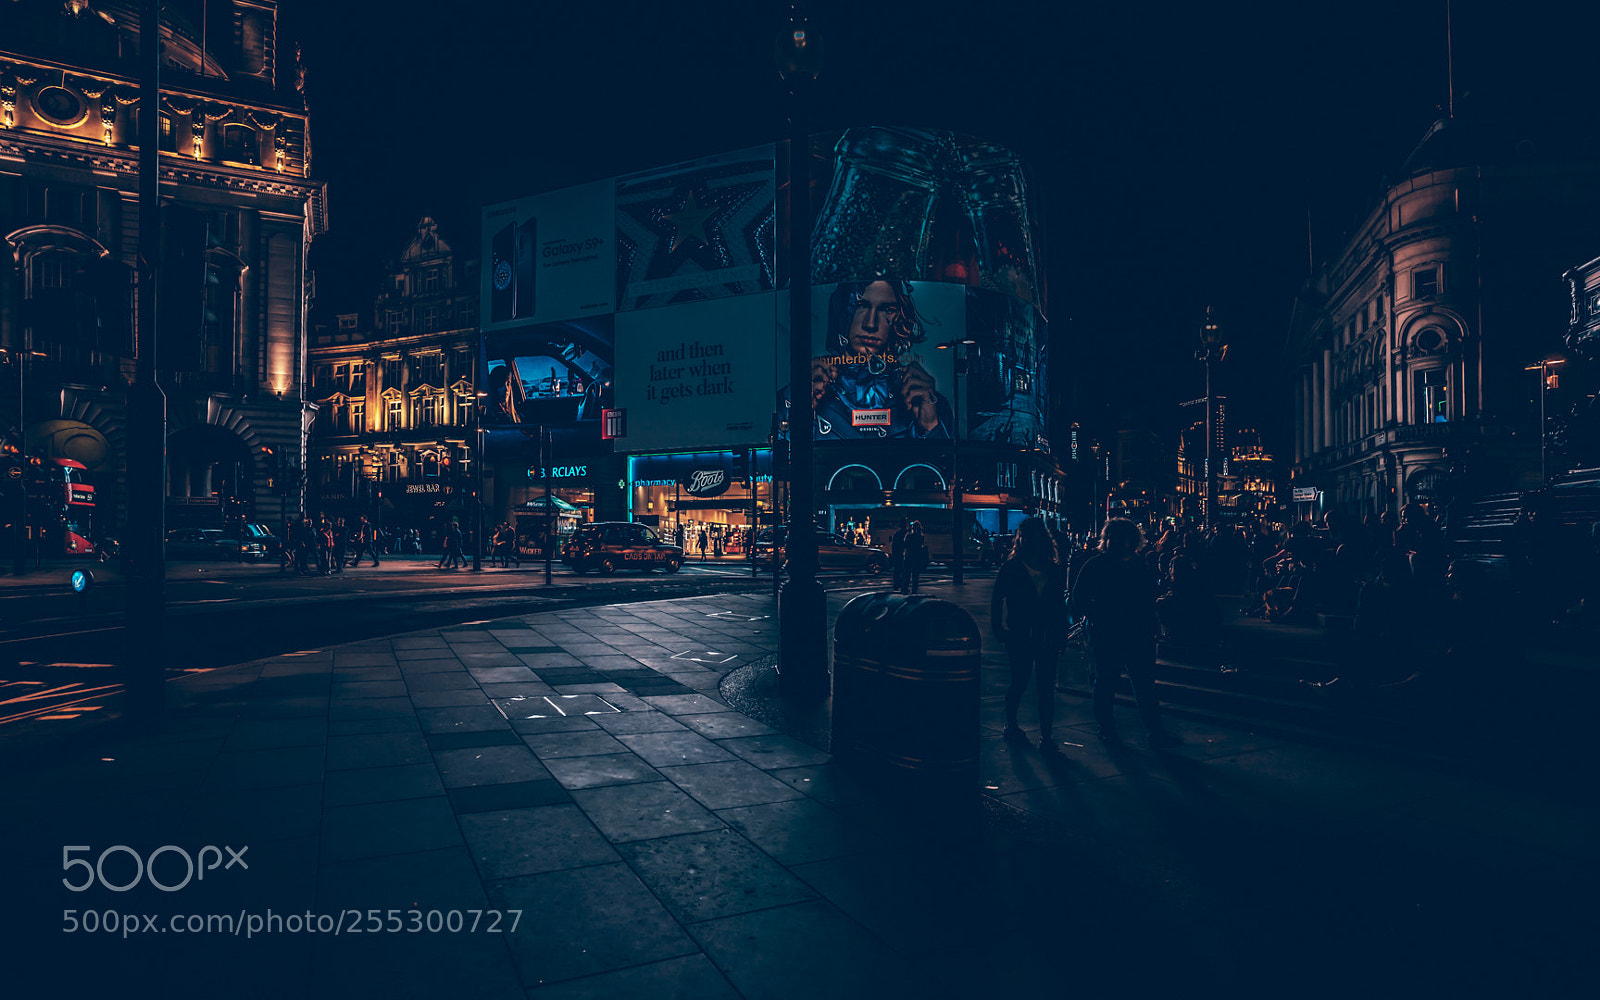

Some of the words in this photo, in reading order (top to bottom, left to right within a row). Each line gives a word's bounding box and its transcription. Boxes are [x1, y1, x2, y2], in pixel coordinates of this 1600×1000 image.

[542, 241, 584, 258] Galaxy
[585, 237, 604, 250] S9+
[657, 342, 685, 362] and
[689, 341, 723, 359] then
[650, 365, 685, 382] later
[689, 360, 731, 377] when
[647, 385, 657, 401] it
[660, 384, 693, 405] gets
[697, 376, 734, 396] dark
[540, 465, 587, 478] BRCLAYS
[687, 470, 725, 492] Boots
[997, 462, 1018, 489] GAP
[426, 483, 440, 493] BAR
[635, 478, 676, 489] pharmacy
